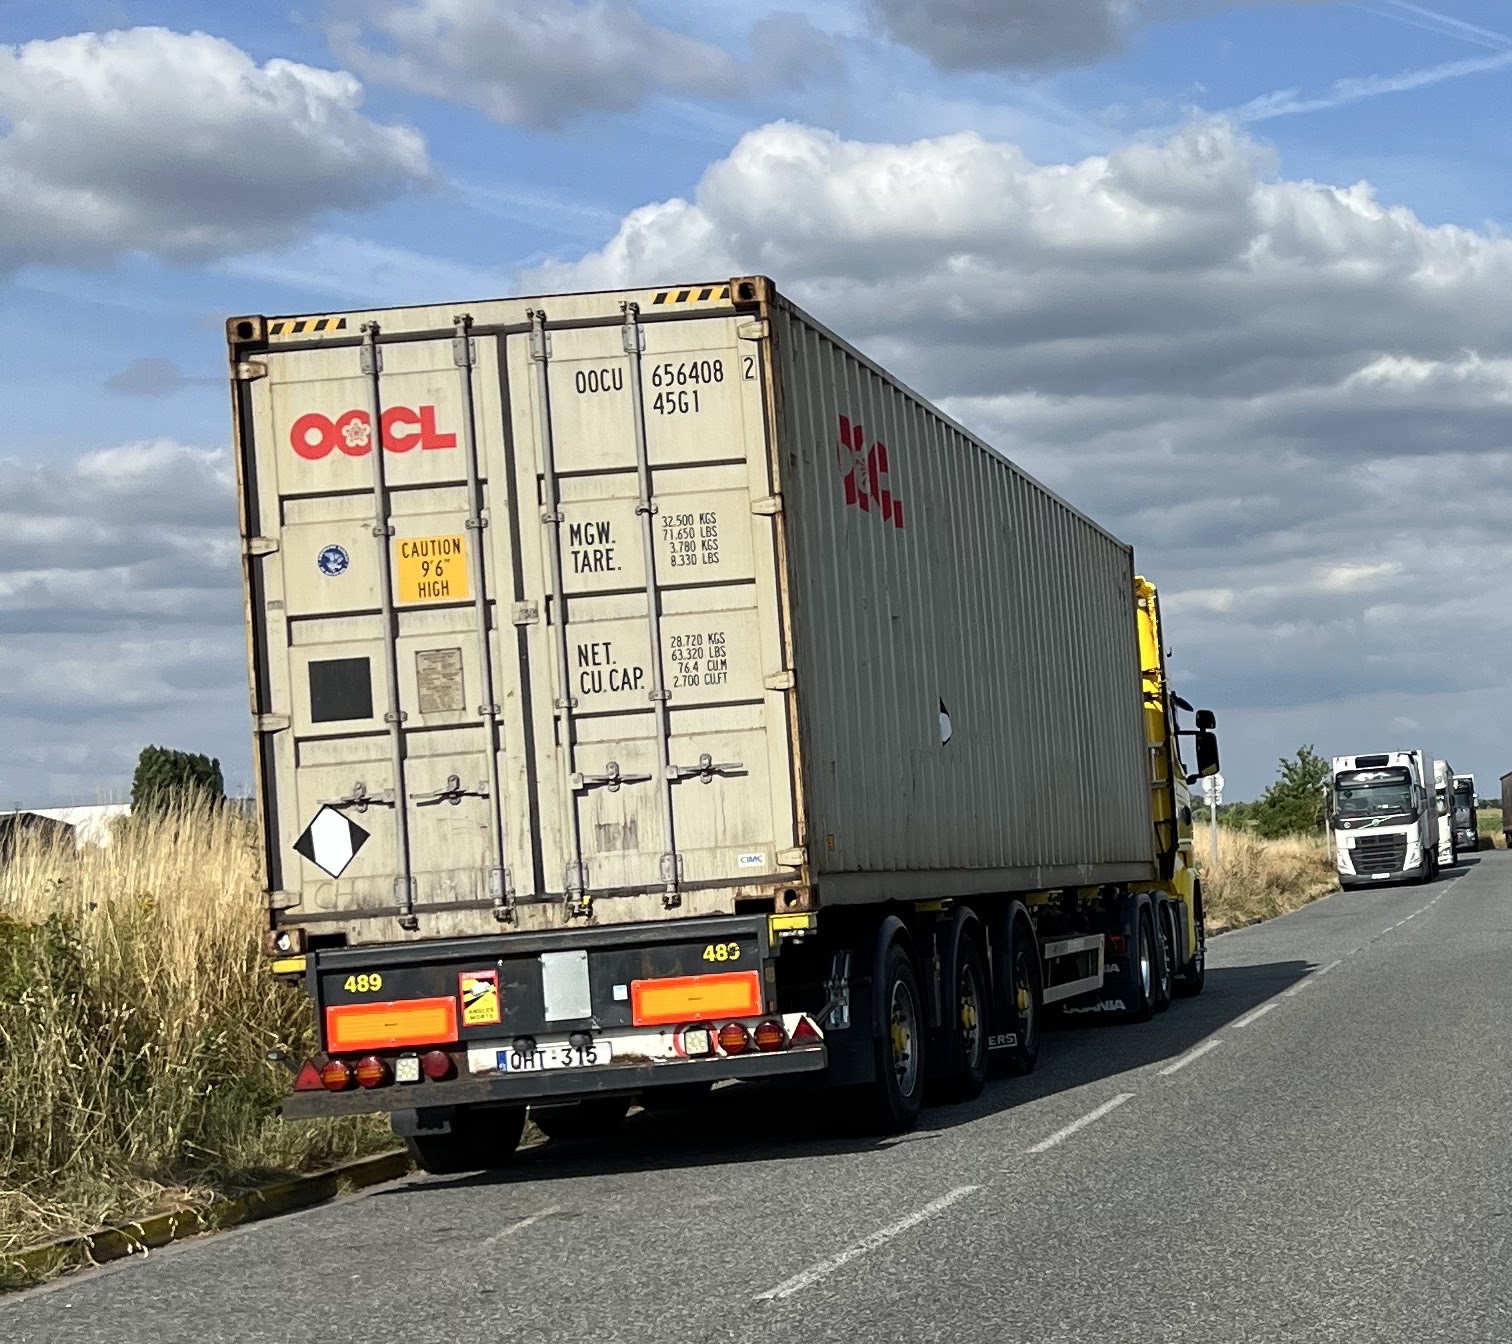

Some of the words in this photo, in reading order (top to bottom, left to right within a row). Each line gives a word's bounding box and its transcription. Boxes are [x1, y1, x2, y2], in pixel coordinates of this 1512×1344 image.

[575, 367, 624, 394] OOCU
[652, 359, 724, 387] 656408
[743, 356, 755, 380] 2
[653, 389, 700, 415] 45G1
[290, 405, 457, 460] OOCL
[661, 513, 695, 528] 32.500
[699, 512, 717, 525] KGS
[569, 521, 616, 546] MGW.
[663, 527, 695, 541] 71.650
[700, 526, 718, 538] LBS
[401, 537, 461, 558] CAUTION
[669, 540, 696, 554] 3.780
[701, 539, 719, 551] KGS
[571, 548, 622, 573] TARE.
[670, 554, 697, 566] 8.330
[702, 552, 720, 565] LBS
[417, 580, 450, 598] HIGH
[670, 633, 703, 648] 28.720
[707, 632, 726, 645] KGS
[577, 642, 616, 667] NET.
[671, 647, 703, 661] 63.320
[709, 646, 726, 659] LBS
[678, 661, 699, 674] 76.4
[673, 674, 700, 688] 2.700
[344, 973, 383, 993] 489
